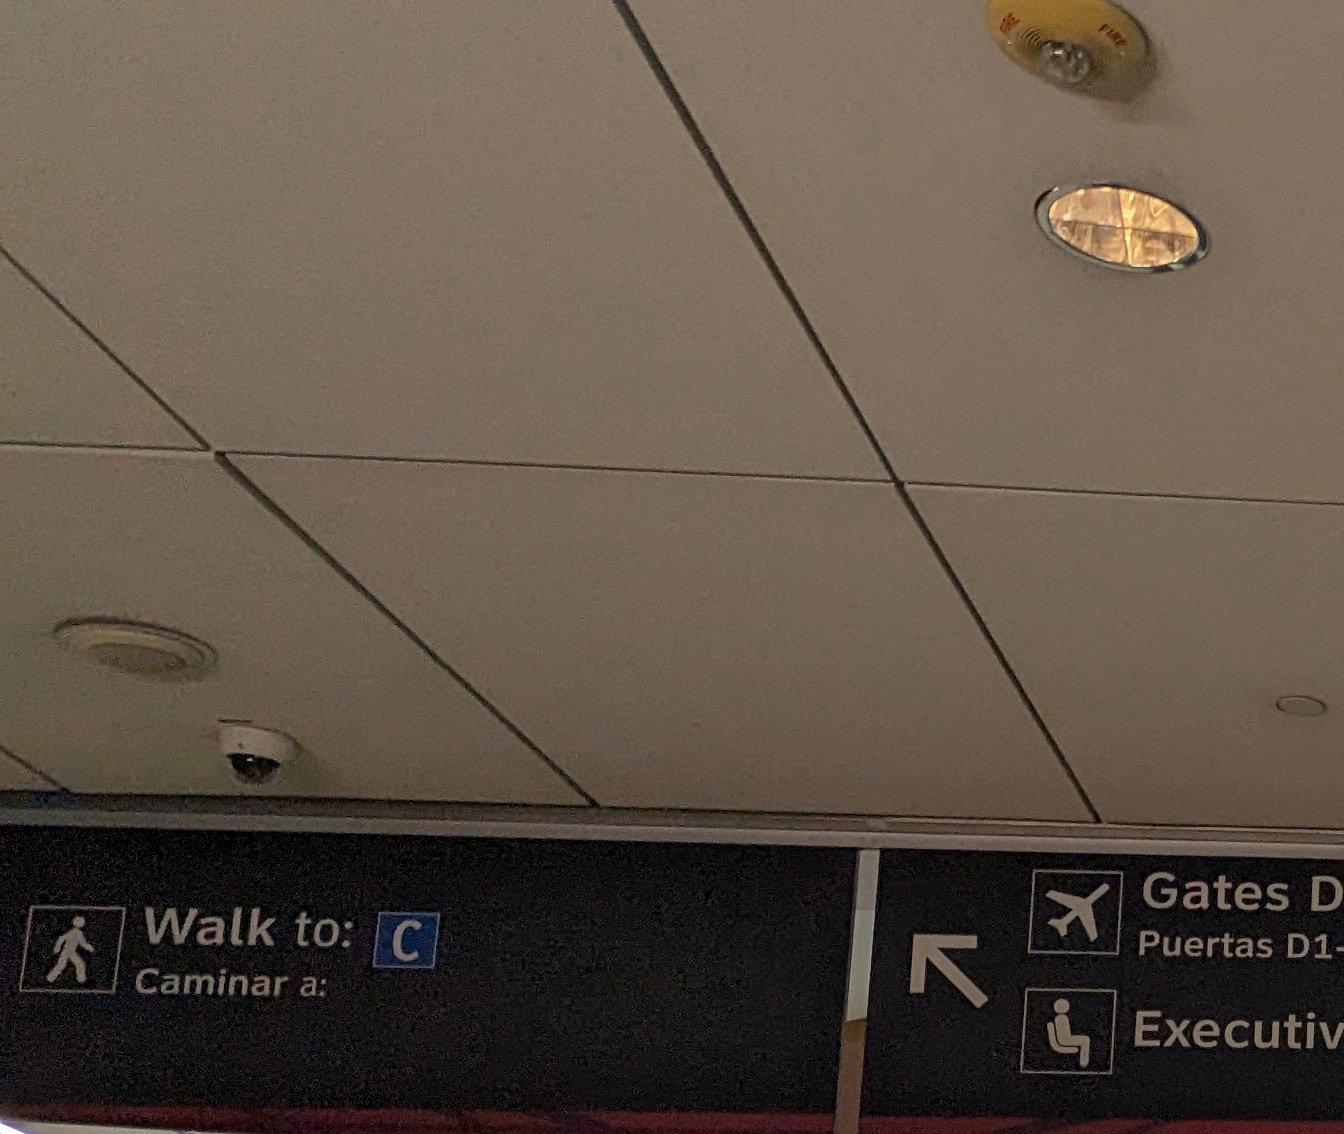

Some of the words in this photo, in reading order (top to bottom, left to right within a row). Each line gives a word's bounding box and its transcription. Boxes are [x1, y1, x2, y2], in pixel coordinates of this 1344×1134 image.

[1142, 871, 1290, 913] Gates
[144, 907, 276, 948] Walk
[294, 911, 352, 948] to:
[391, 919, 424, 962] C
[1139, 929, 1273, 960] Puertas
[135, 967, 286, 999] Caminar
[299, 973, 328, 998] a:
